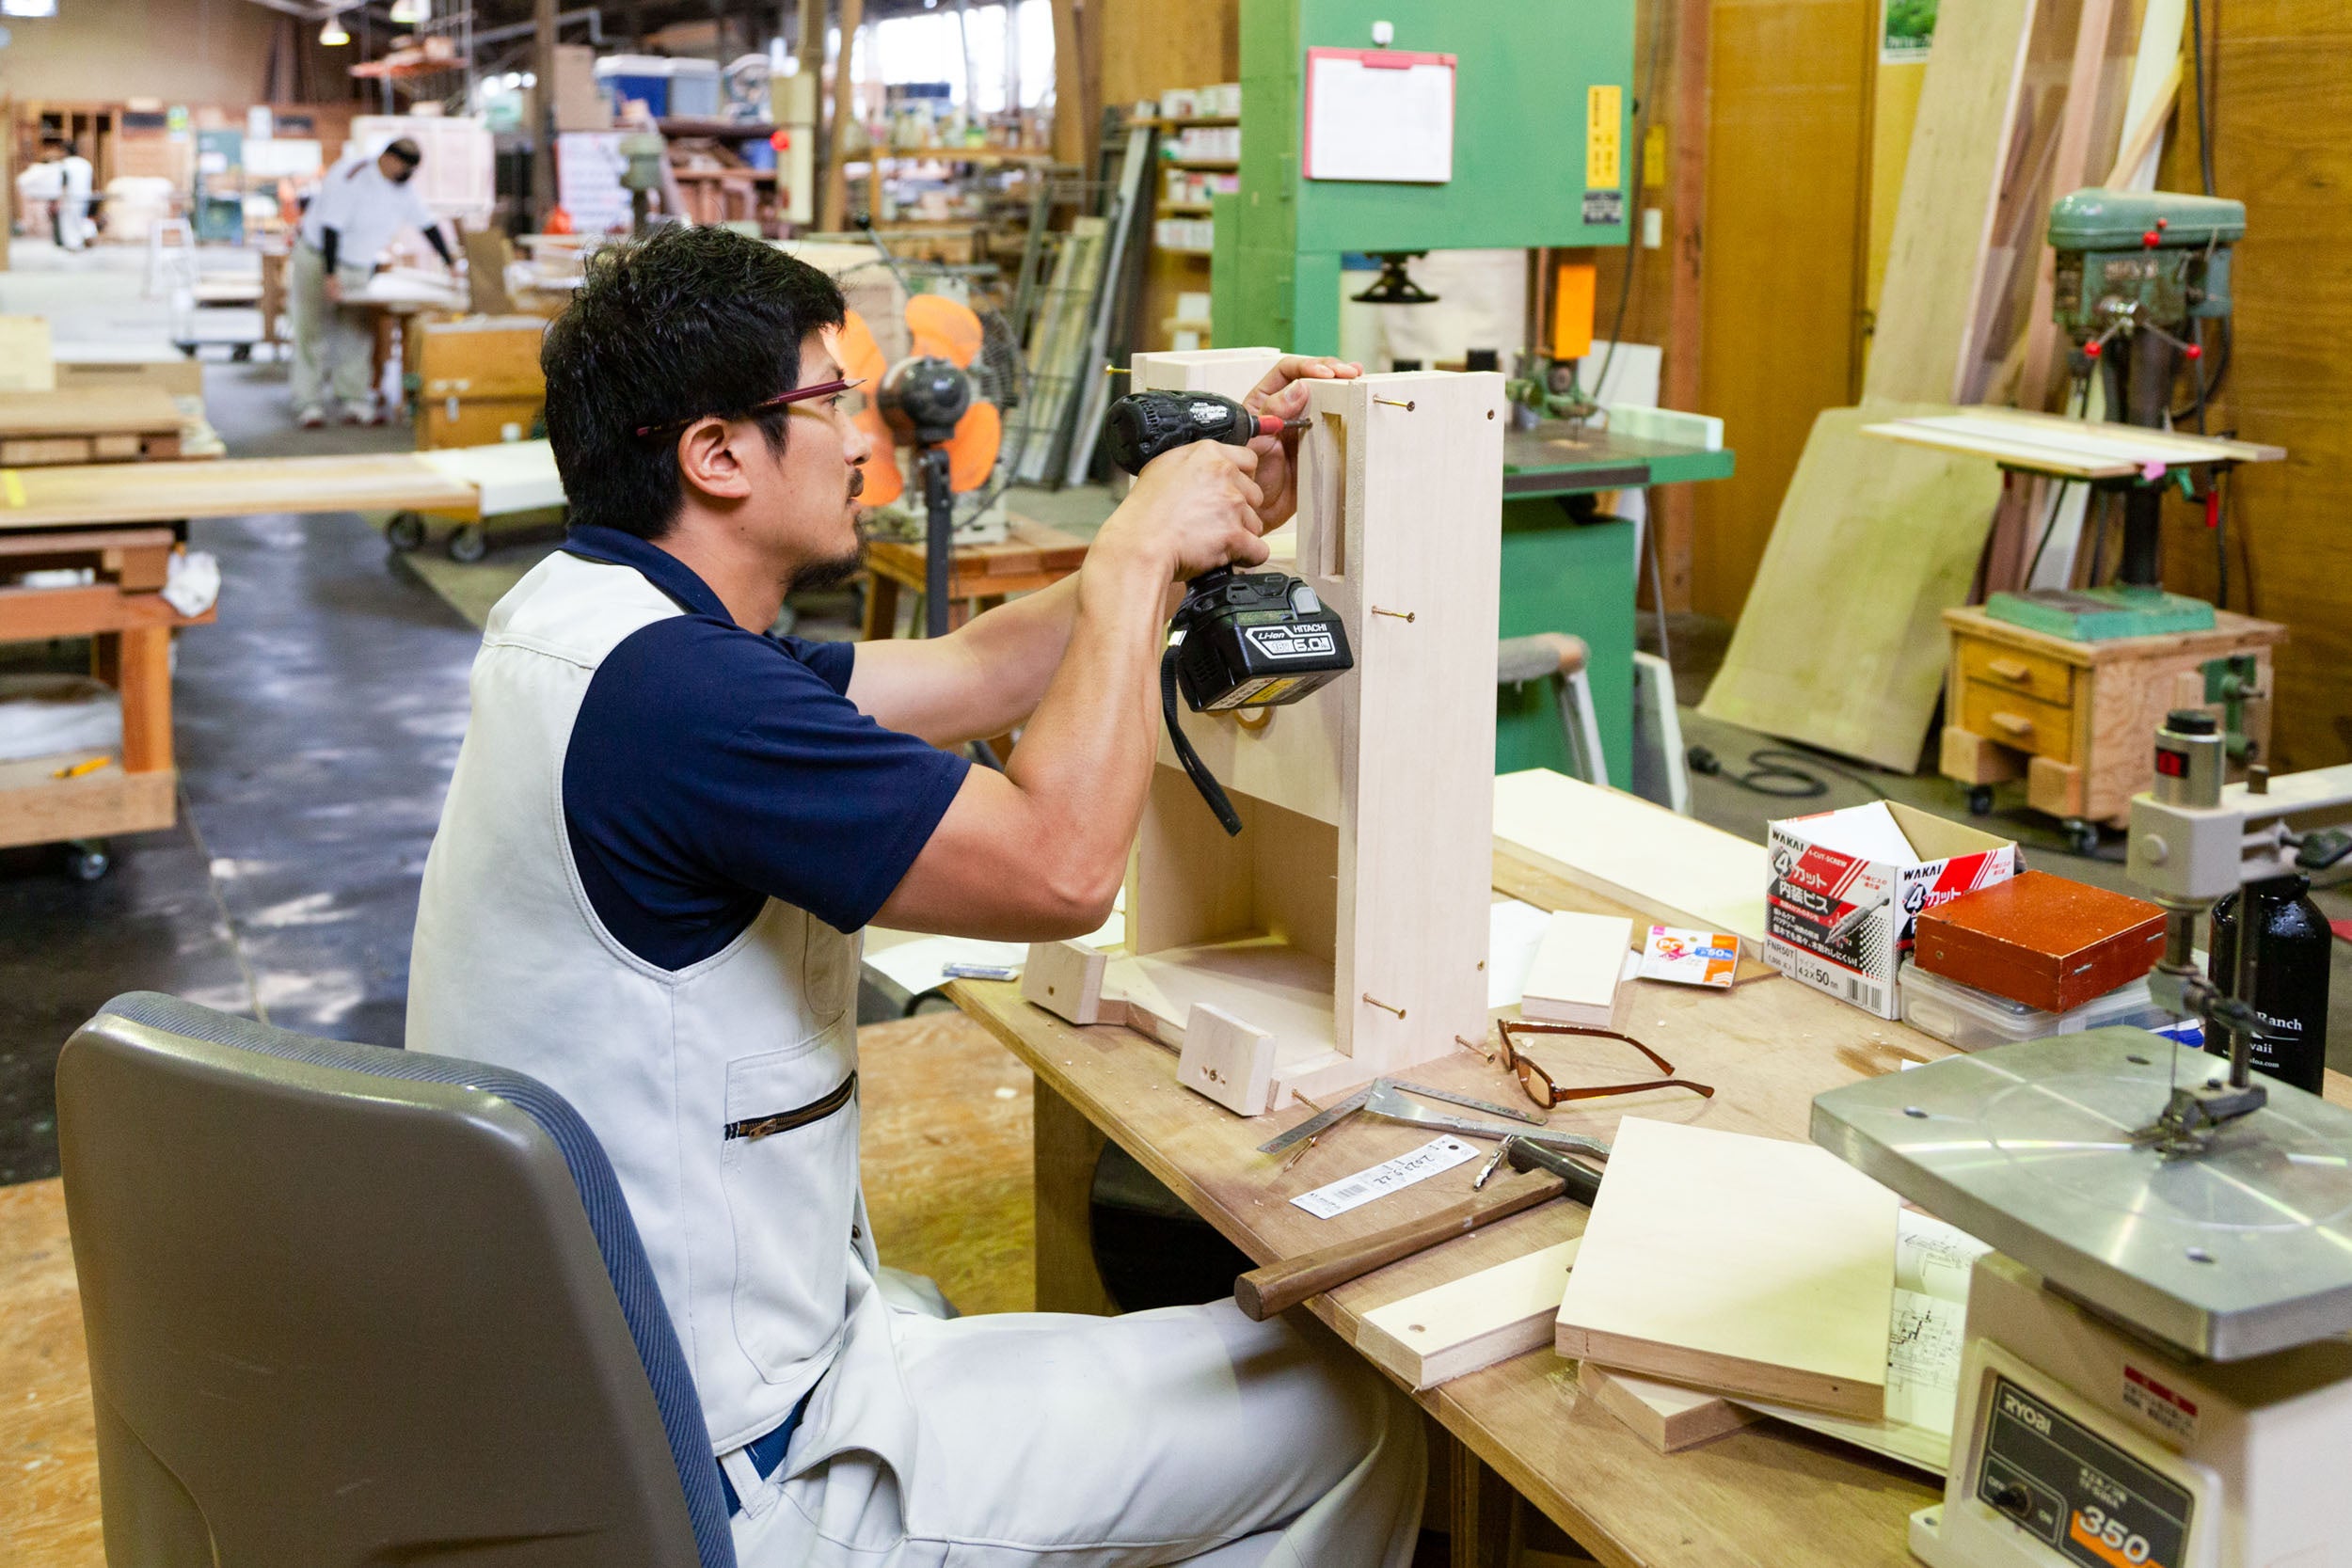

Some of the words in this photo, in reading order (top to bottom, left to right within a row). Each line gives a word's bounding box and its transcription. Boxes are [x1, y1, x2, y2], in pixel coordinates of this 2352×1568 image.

[1293, 624, 1327, 633] HITACHI
[1772, 830, 1804, 852] WAKAI
[1903, 864, 1942, 880] WAKAI
[2004, 1393, 2052, 1435] RYOBI
[2078, 1505, 2151, 1566] 350
